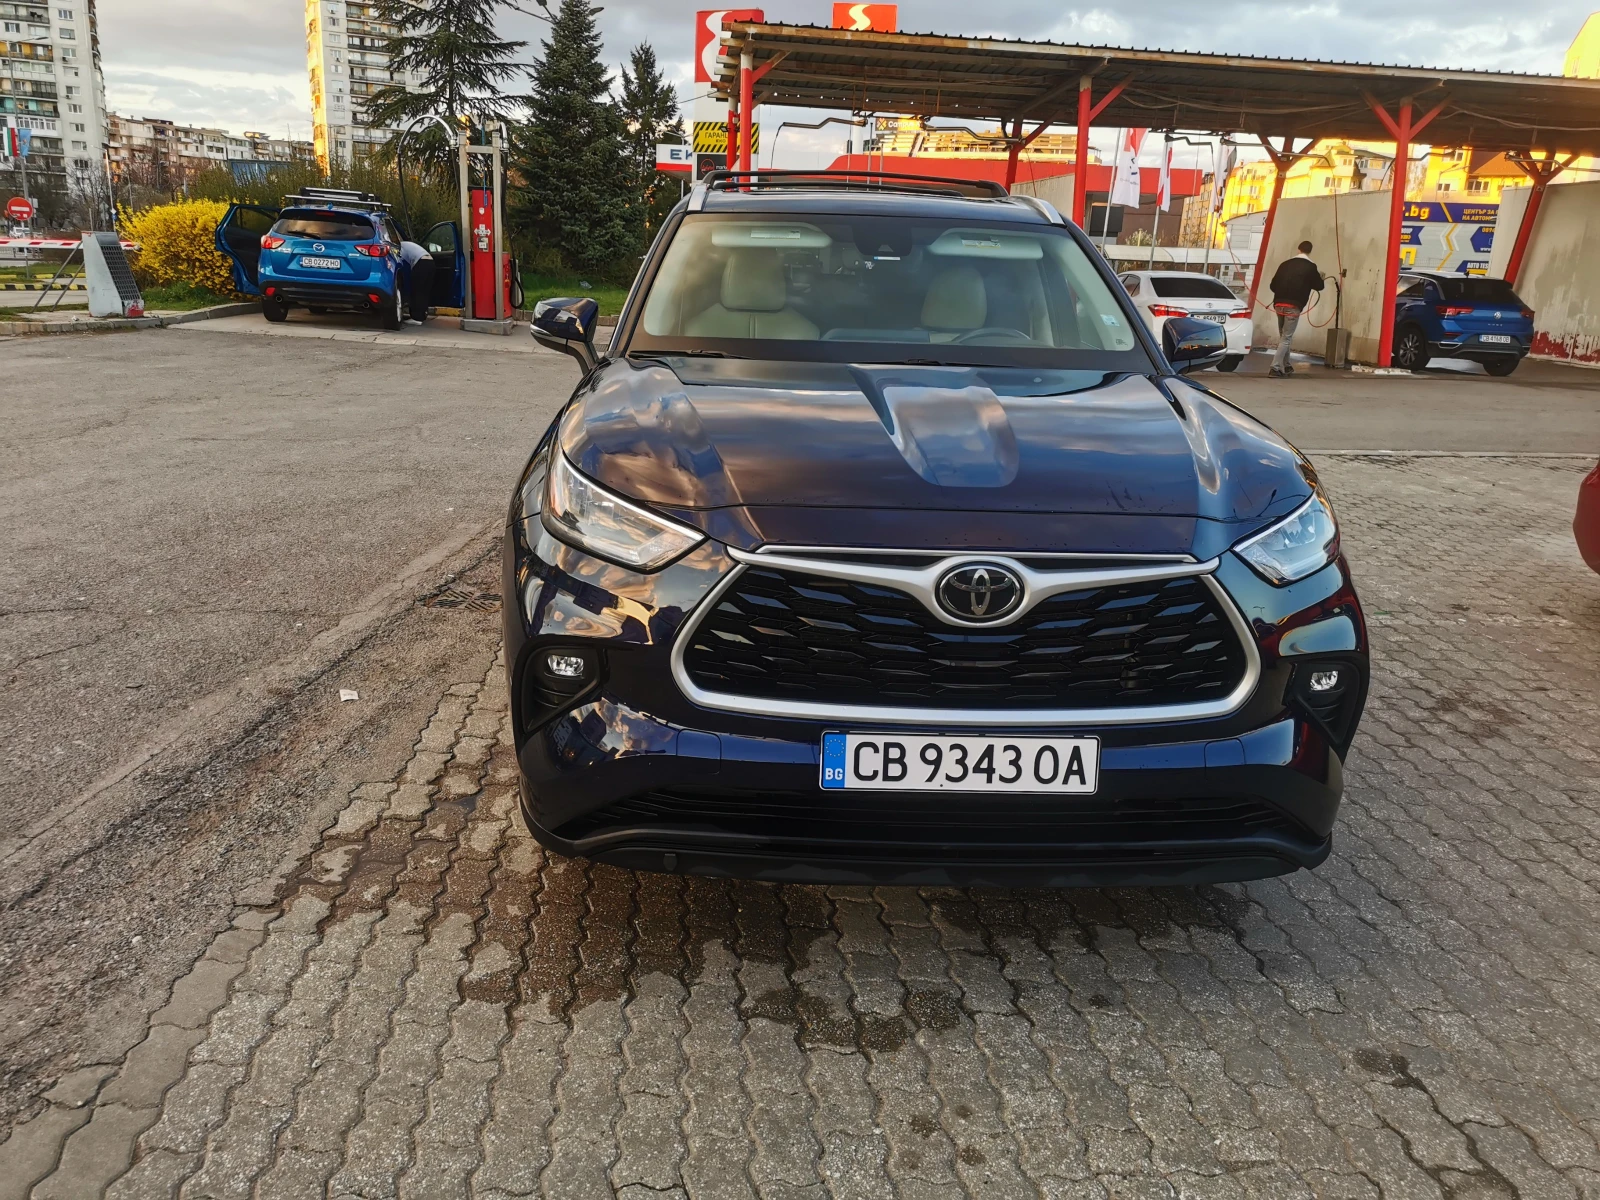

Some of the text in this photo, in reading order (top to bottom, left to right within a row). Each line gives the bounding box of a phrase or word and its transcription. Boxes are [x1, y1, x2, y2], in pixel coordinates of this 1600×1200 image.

[1402, 205, 1430, 220] .bg
[303, 257, 312, 265] CB
[853, 741, 1087, 785] CB 9343 OA
[825, 767, 843, 780] BG
